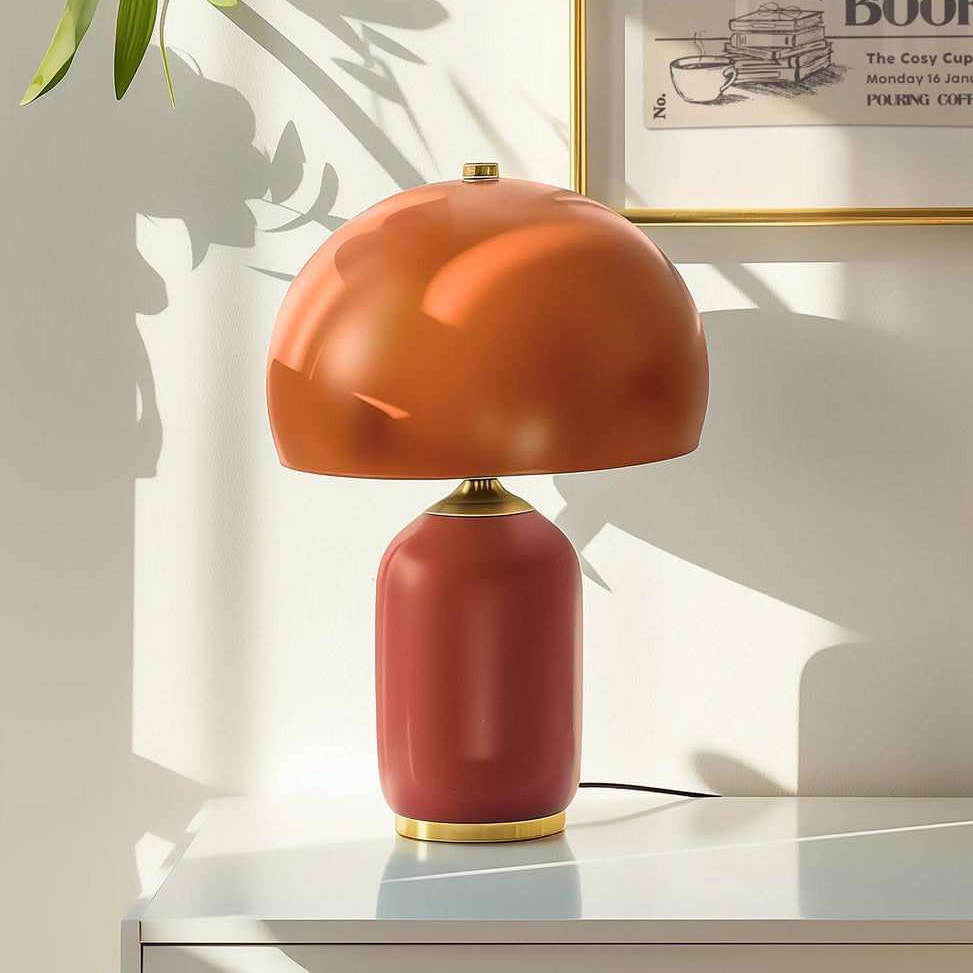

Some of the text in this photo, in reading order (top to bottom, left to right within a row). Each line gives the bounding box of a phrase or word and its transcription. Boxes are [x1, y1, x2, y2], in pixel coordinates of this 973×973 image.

[866, 53, 895, 64] The
[900, 53, 937, 66] Cosy
[942, 53, 973, 67] Cup
[866, 74, 924, 86] Monday
[927, 74, 940, 84] 16
[653, 93, 666, 119] No.
[867, 94, 929, 106] POURING
